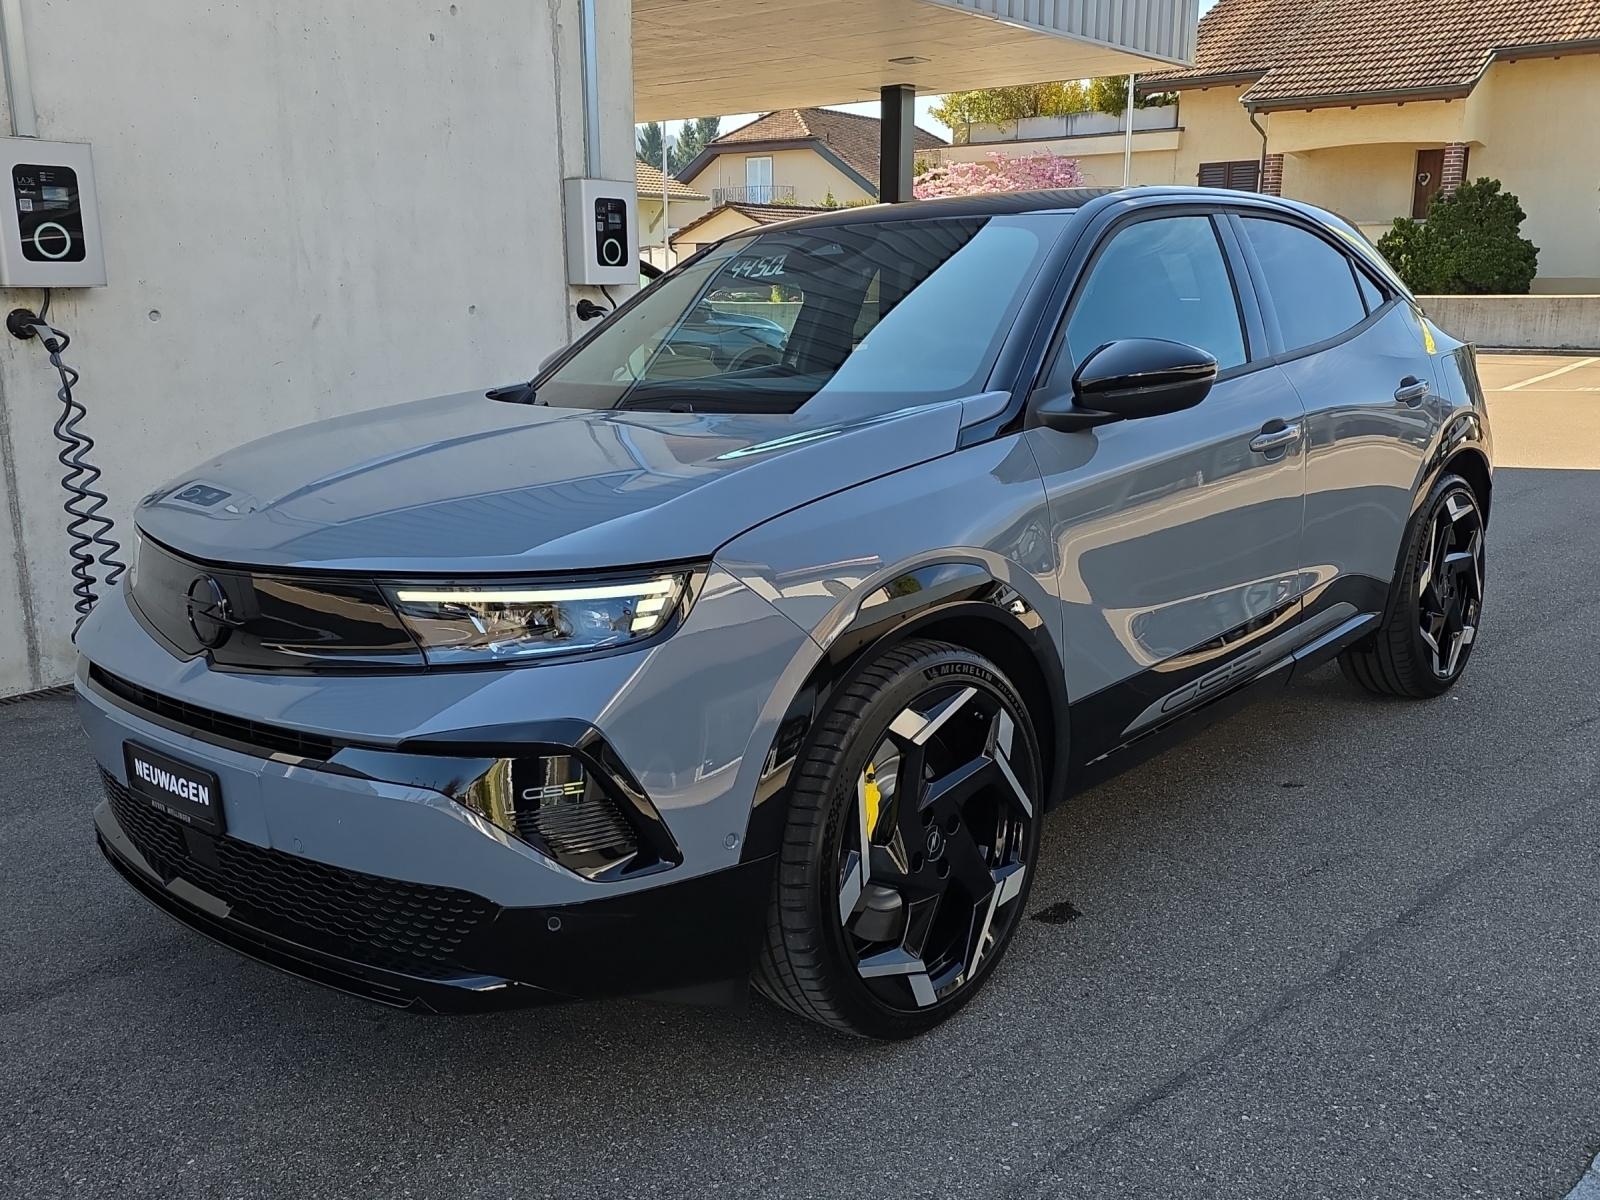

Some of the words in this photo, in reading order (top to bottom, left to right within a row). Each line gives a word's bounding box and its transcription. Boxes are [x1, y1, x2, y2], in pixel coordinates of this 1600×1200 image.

[940, 664, 993, 682] MICHELIN
[134, 757, 209, 806] NEUWAGEN
[522, 781, 585, 800] GSE
